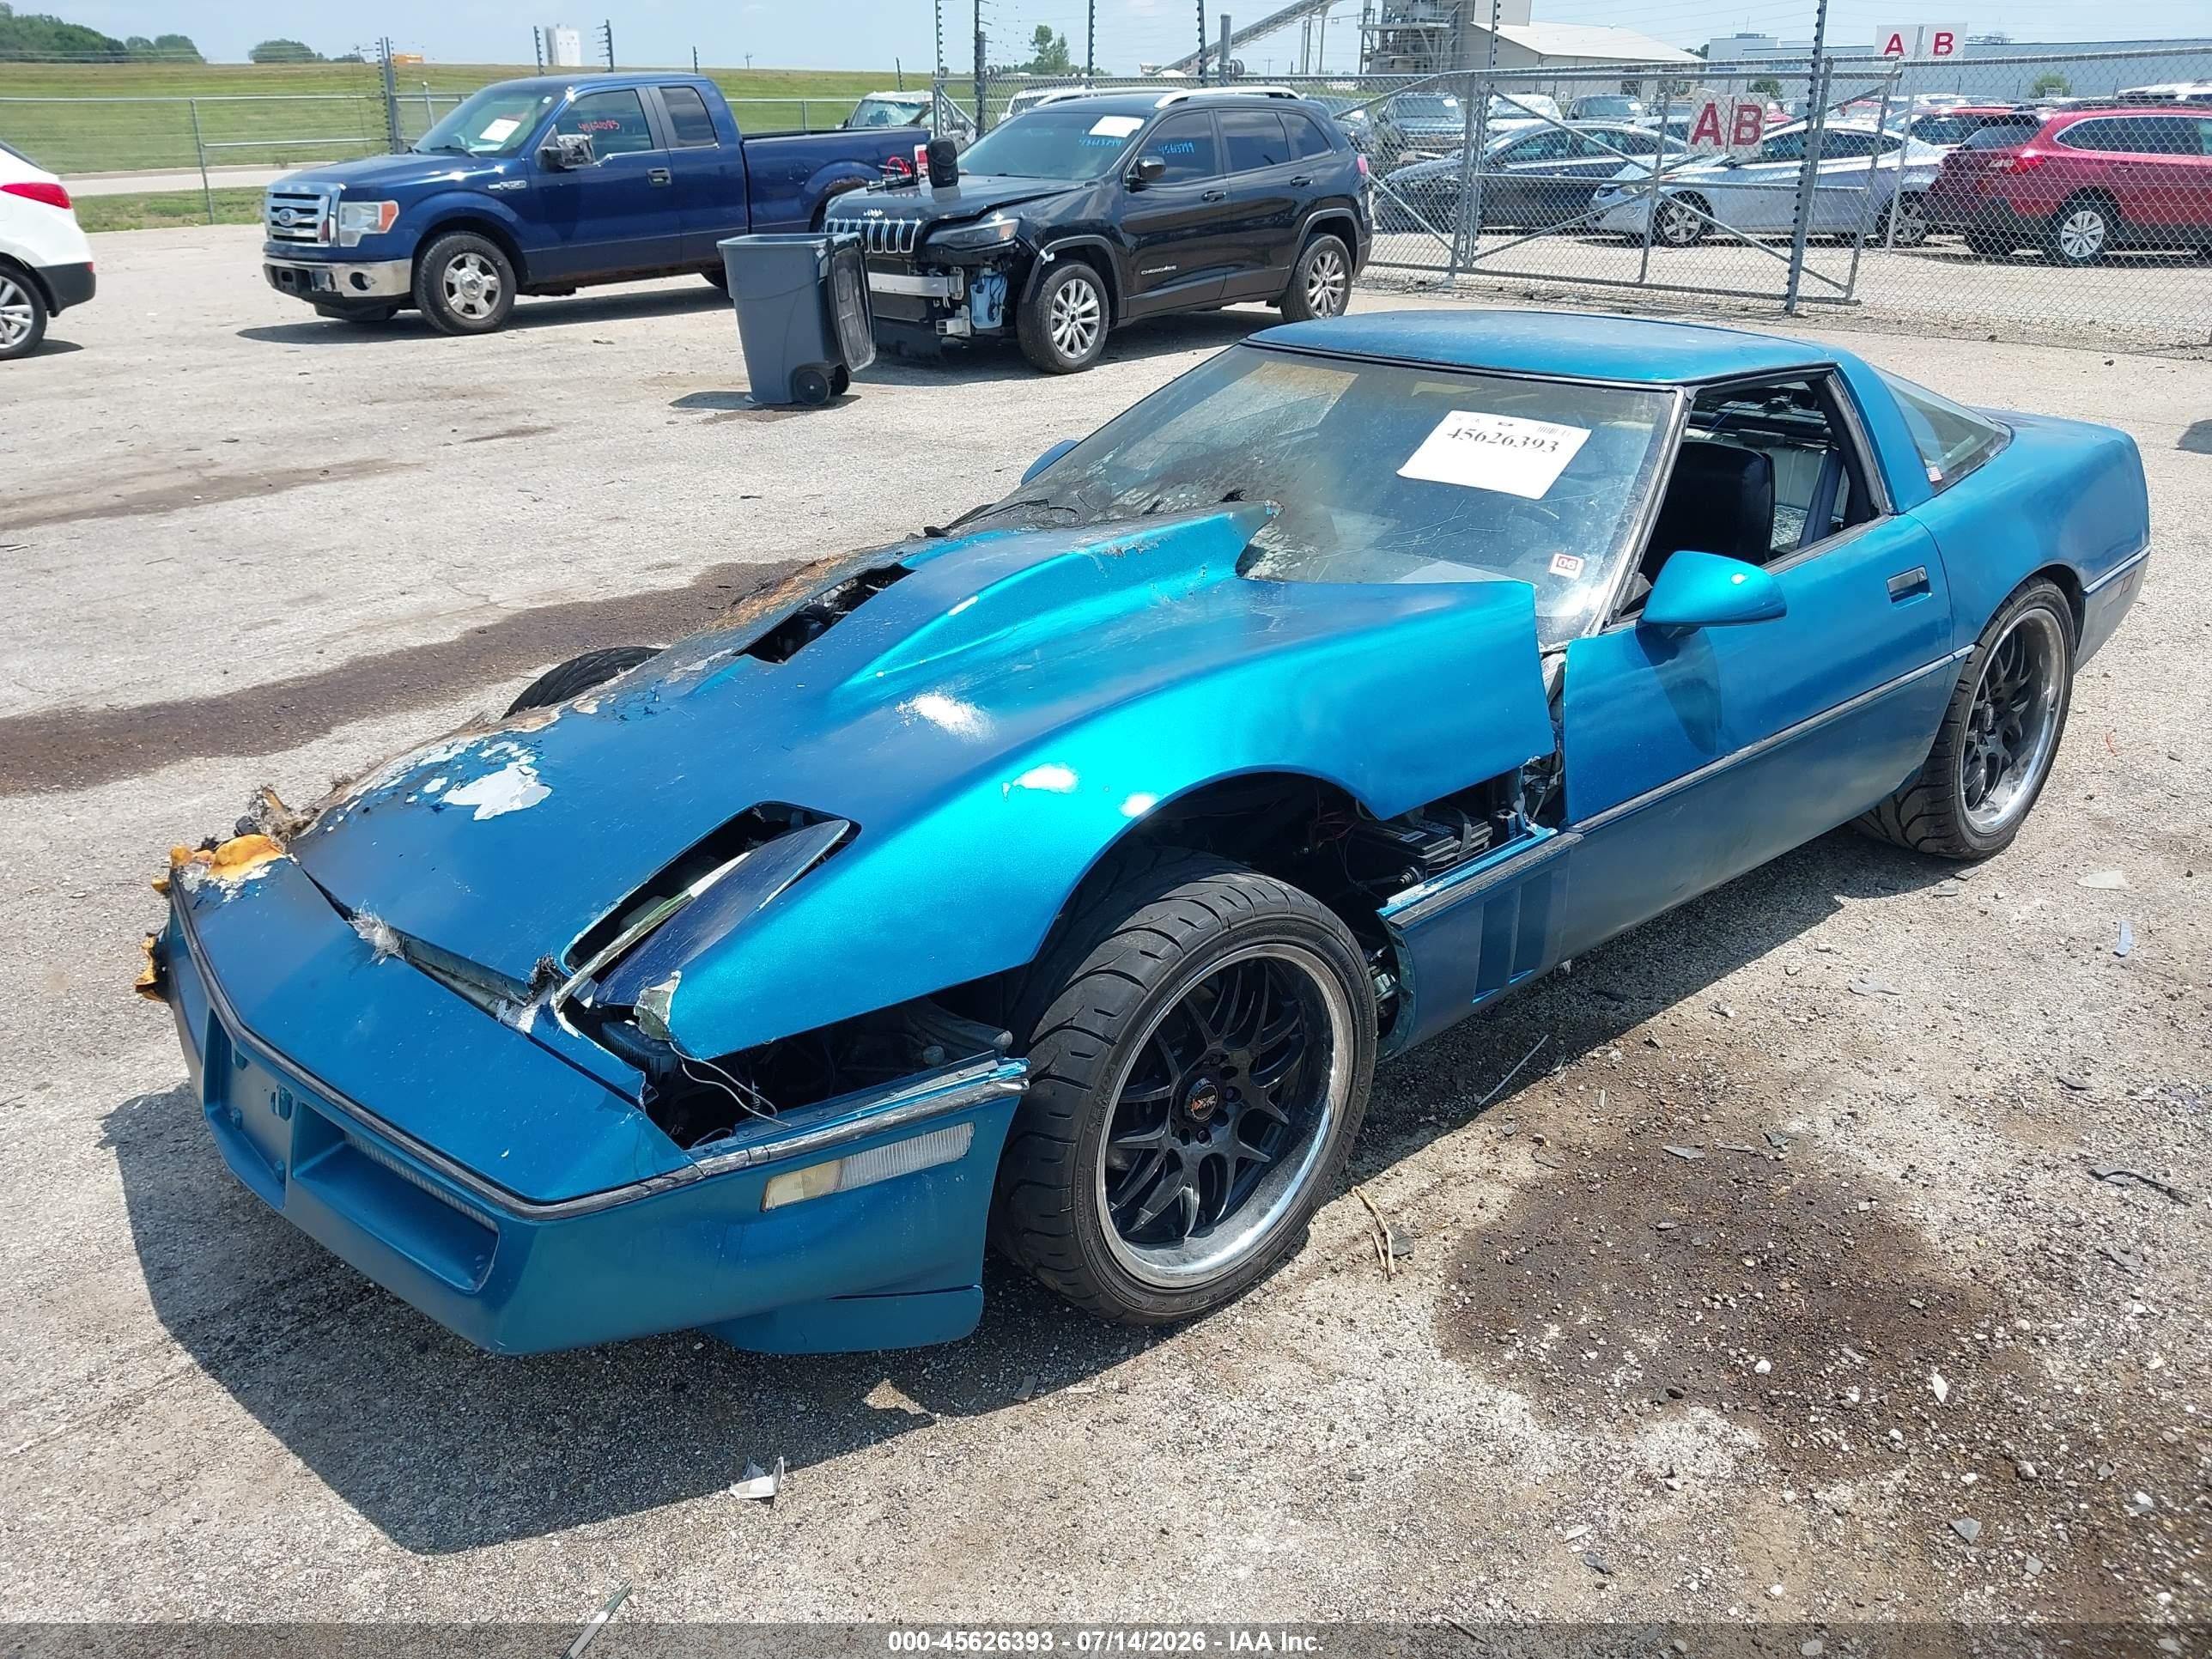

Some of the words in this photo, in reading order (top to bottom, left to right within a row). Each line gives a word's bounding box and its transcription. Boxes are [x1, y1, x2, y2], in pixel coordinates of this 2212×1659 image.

[1883, 33, 1905, 56] A
[1932, 32, 1954, 57] B
[1690, 102, 1722, 146] A
[1733, 104, 1762, 146] B
[1447, 427, 1560, 454] 45626393
[1557, 557, 1577, 571] 06
